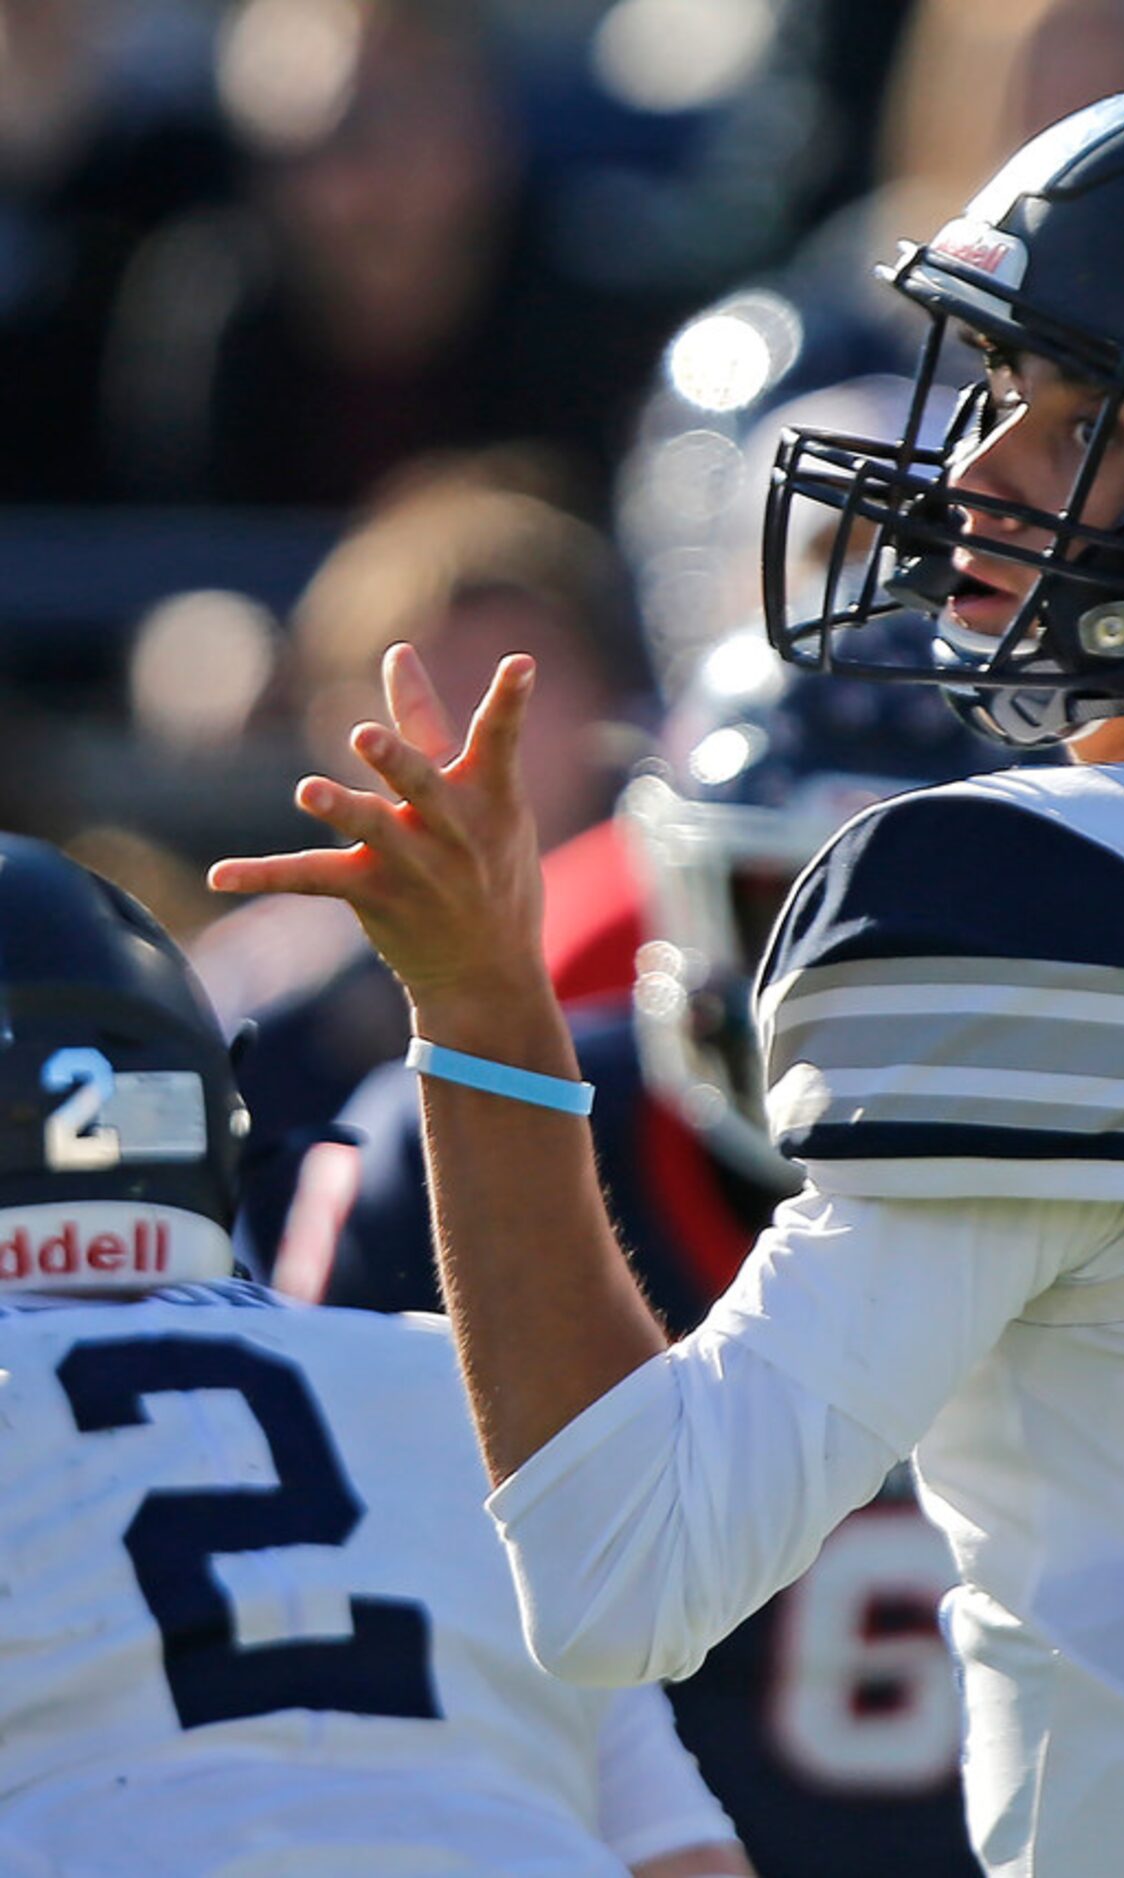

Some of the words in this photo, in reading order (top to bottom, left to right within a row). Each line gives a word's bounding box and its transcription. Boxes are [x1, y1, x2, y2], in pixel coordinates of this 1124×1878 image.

[40, 1046, 121, 1174] 2
[55, 1329, 446, 1731] 2
[764, 1502, 964, 1798] 6
